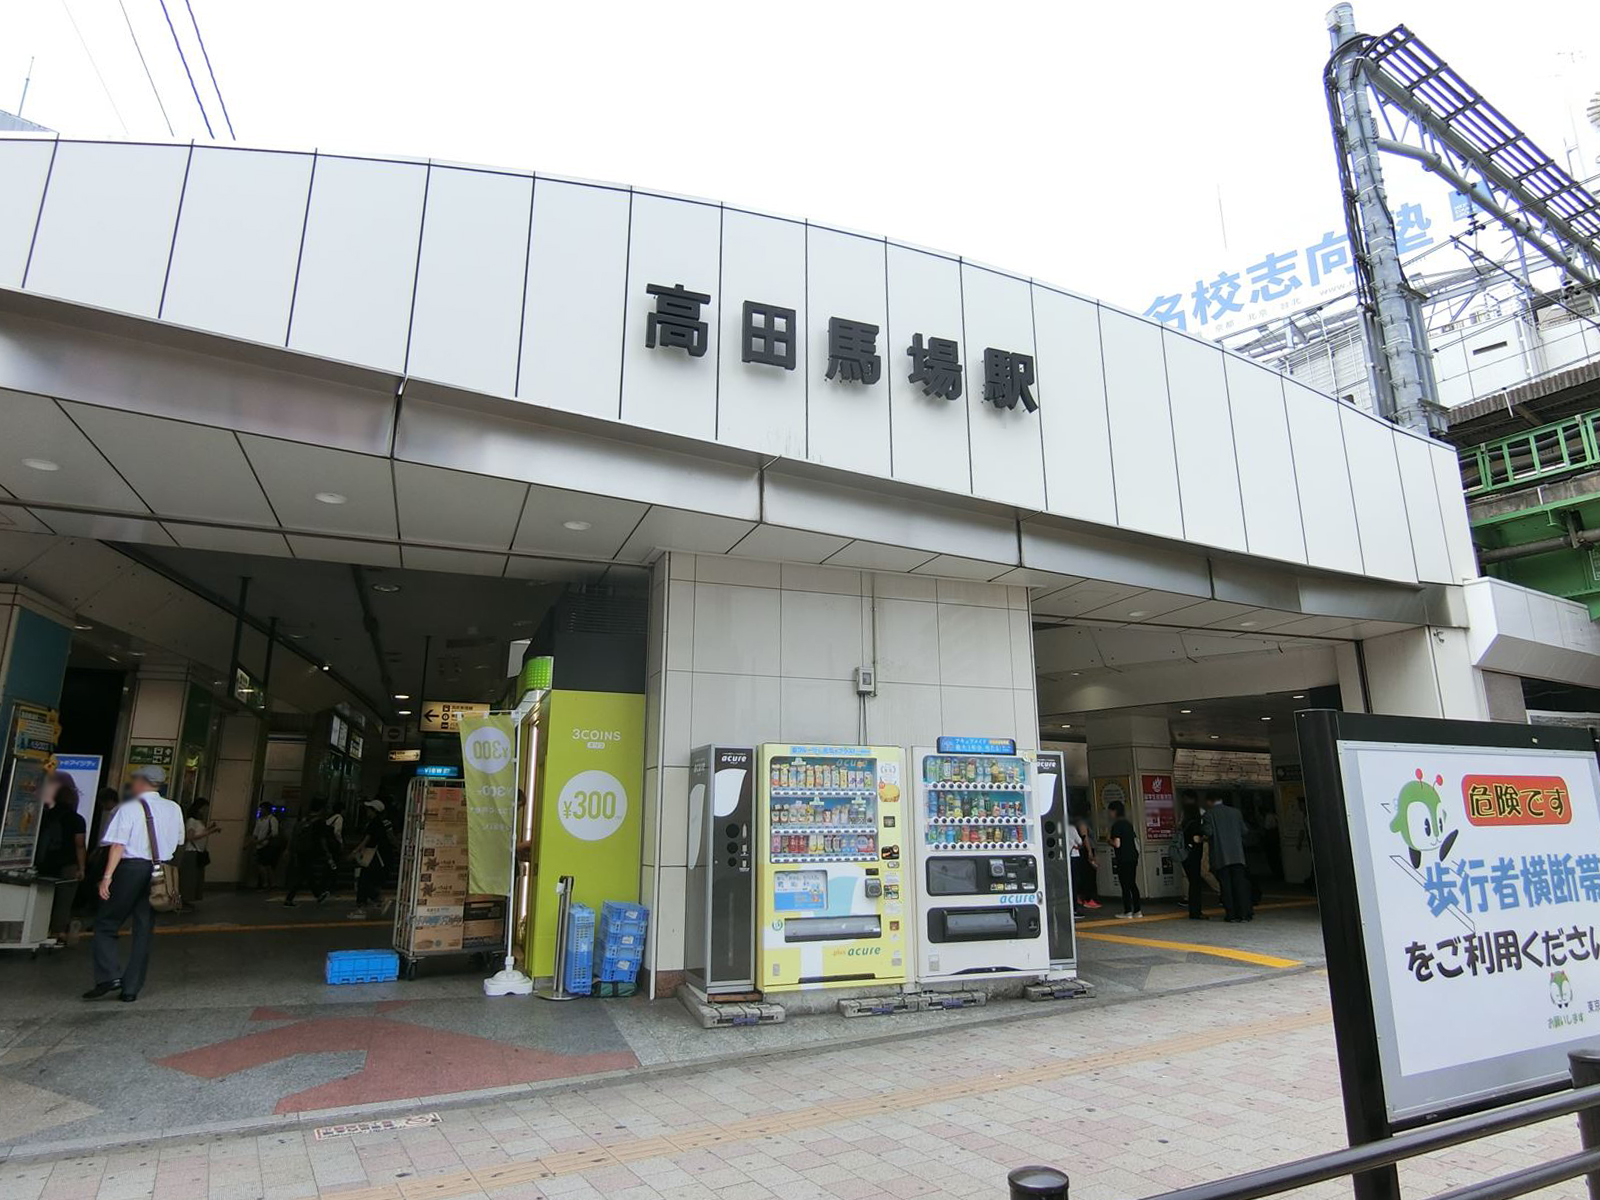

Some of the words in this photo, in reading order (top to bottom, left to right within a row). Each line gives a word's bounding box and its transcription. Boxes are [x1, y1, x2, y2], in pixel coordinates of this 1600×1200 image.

[645, 283, 1039, 414] 高田馬場駅
[572, 728, 622, 741] 3COINS
[721, 754, 747, 764] acure
[563, 790, 617, 819] ¥300
[1469, 784, 1568, 819] 危険です
[1424, 853, 1600, 918] 歩行者横断帯
[1000, 893, 1036, 904] acure
[847, 945, 881, 957] acure
